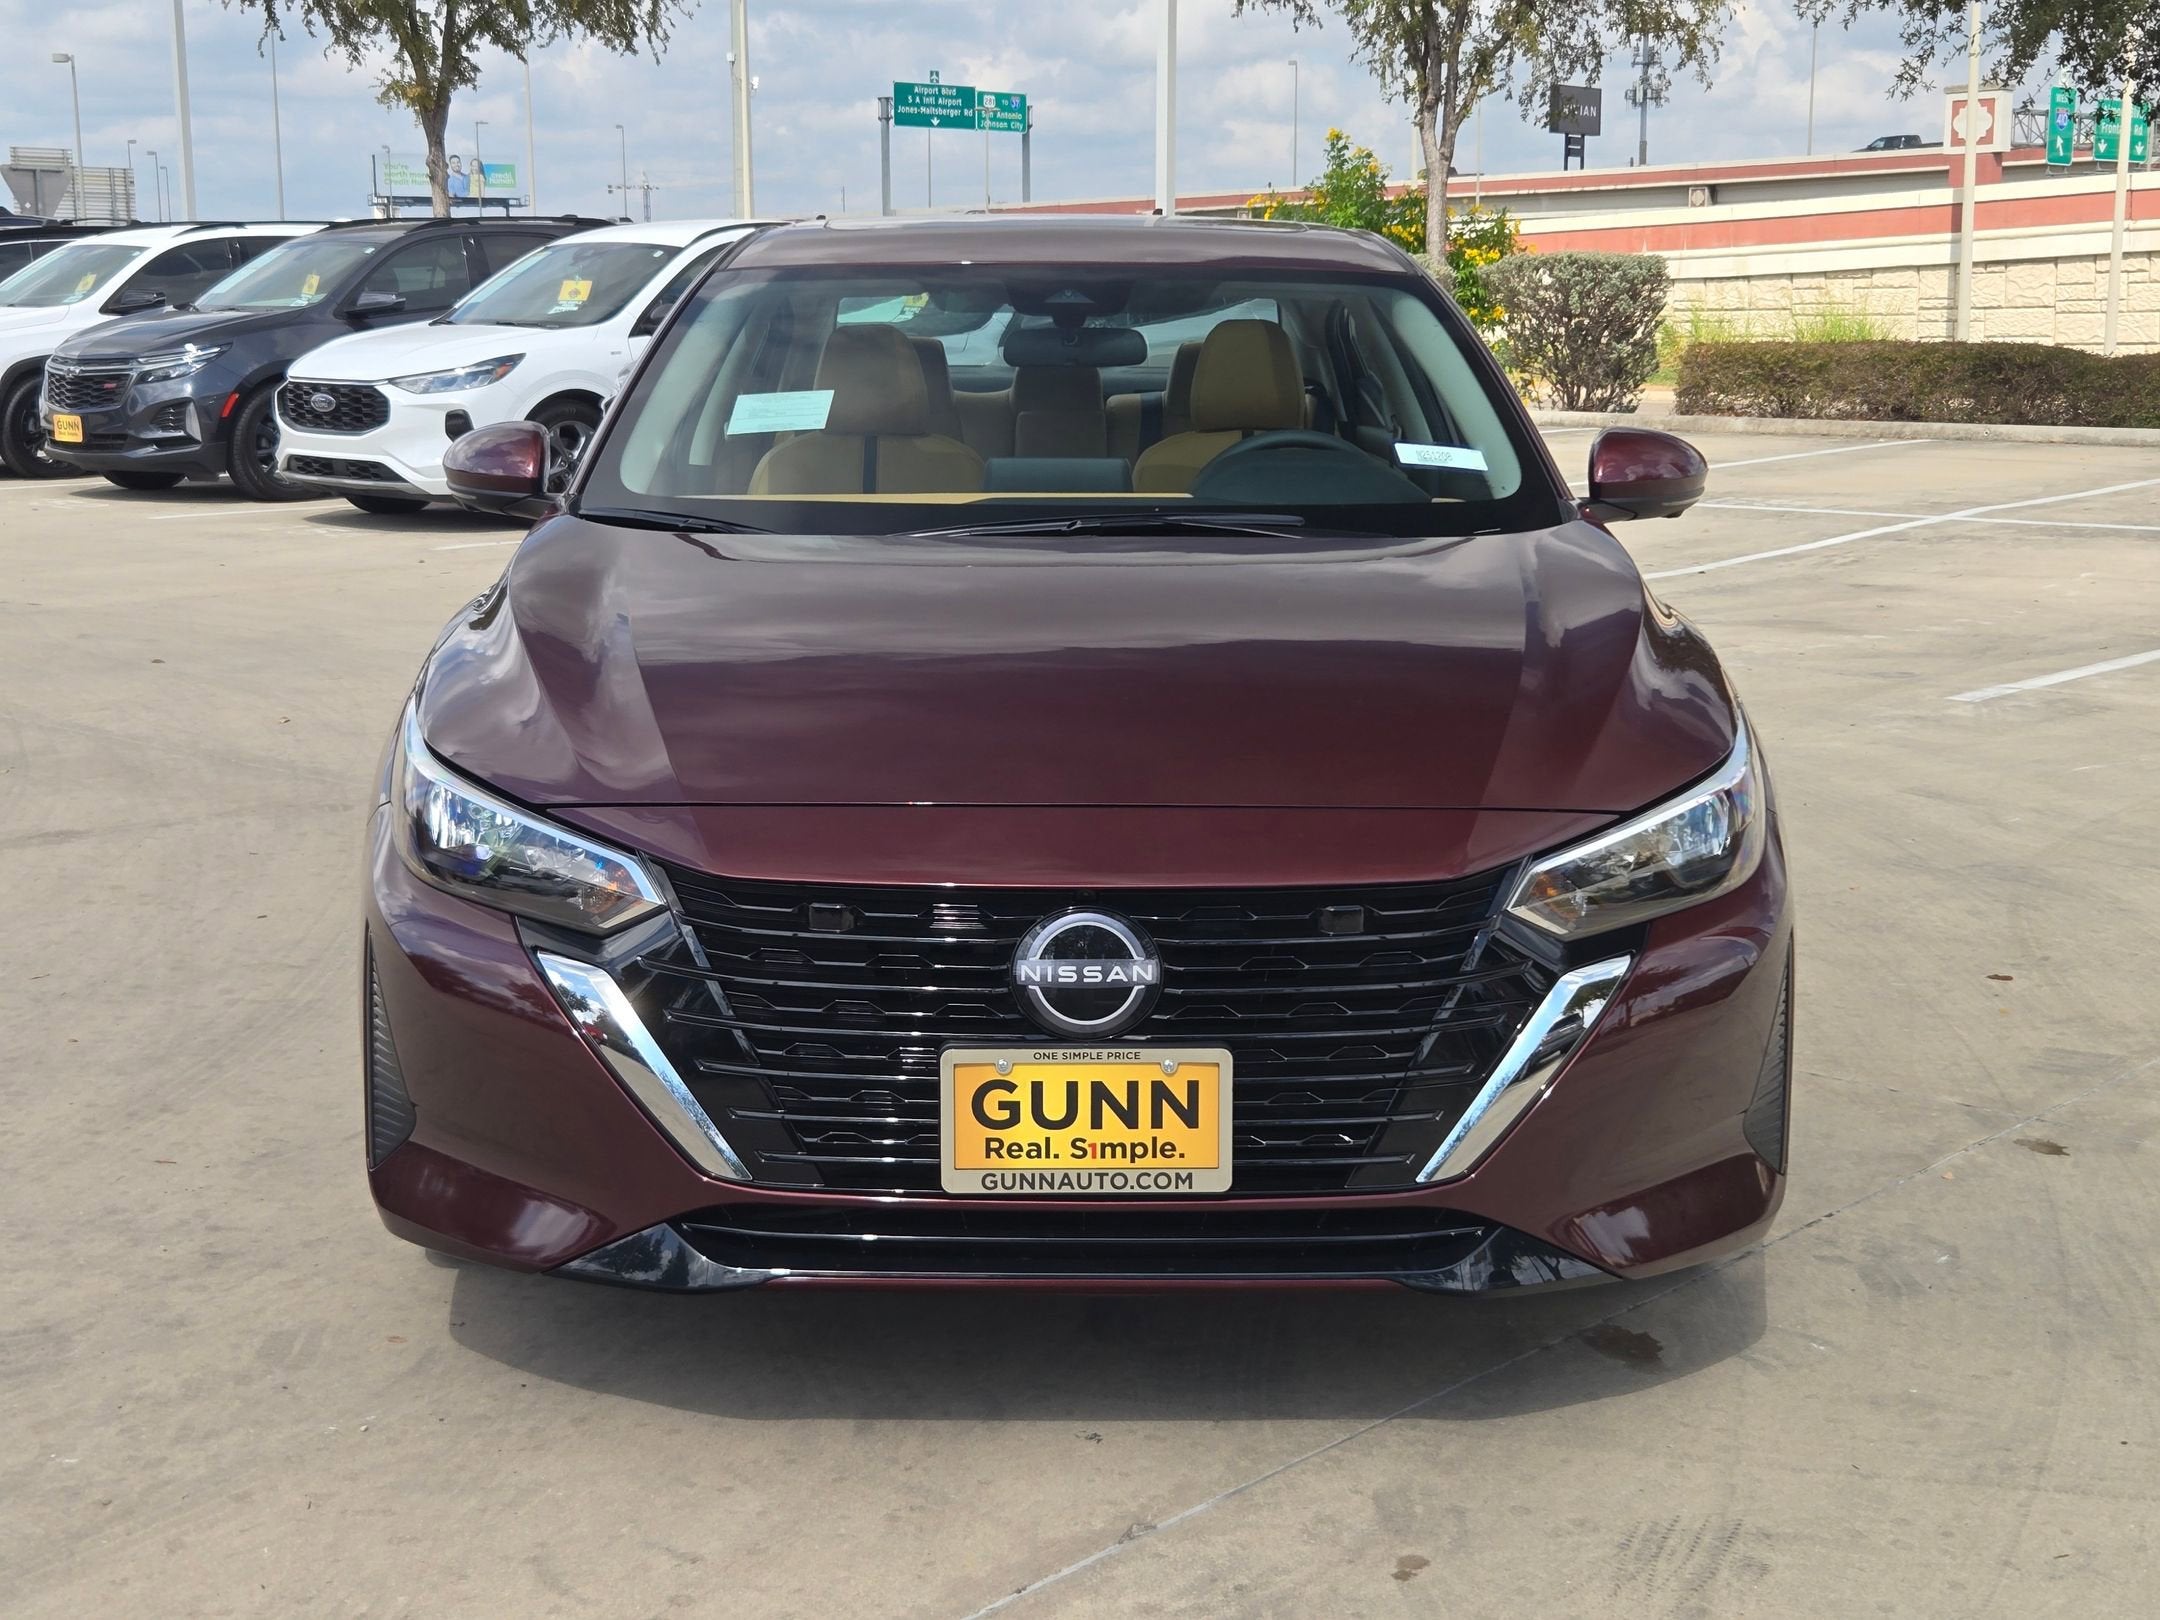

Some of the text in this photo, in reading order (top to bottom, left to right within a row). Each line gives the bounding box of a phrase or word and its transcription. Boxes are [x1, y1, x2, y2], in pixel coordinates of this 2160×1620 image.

[914, 86, 957, 96] Airport Blvd
[908, 95, 913, 103] S
[915, 96, 920, 104] A
[938, 98, 962, 107] Airport
[985, 97, 995, 105] 281
[898, 105, 973, 117] Jones-Maltsberger Rd
[981, 110, 1023, 120] Sn Antonio
[1010, 121, 1024, 131] City
[2134, 124, 2144, 136] Rd
[56, 420, 80, 432] GUNN
[1021, 964, 1153, 984] NISSAN
[1033, 1051, 1141, 1060] ONE SIMPLE PRICE
[971, 1079, 1199, 1130] GUNN
[985, 1137, 1060, 1160] Real.
[981, 1172, 1193, 1190] GUNNAUTO.COM
